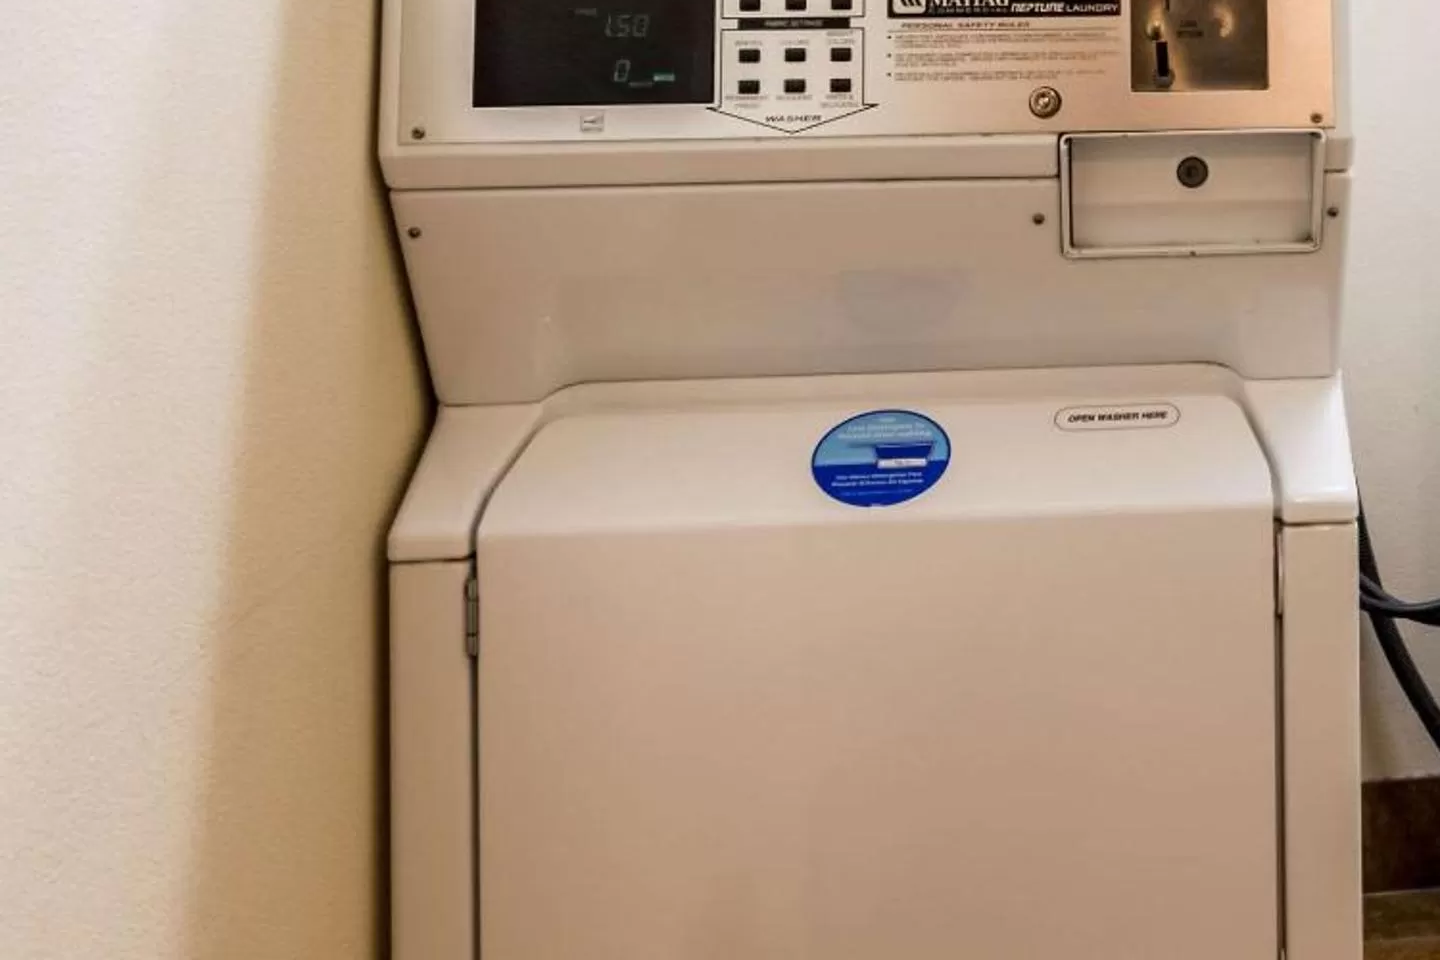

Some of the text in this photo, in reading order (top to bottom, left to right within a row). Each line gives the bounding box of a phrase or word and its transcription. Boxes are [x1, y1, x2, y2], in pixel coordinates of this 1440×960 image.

[1011, 2, 1065, 13] NEPTUNE
[1066, 3, 1119, 13] LAUNDRY
[1067, 414, 1096, 423] OPEN
[1097, 412, 1140, 421] WASHER
